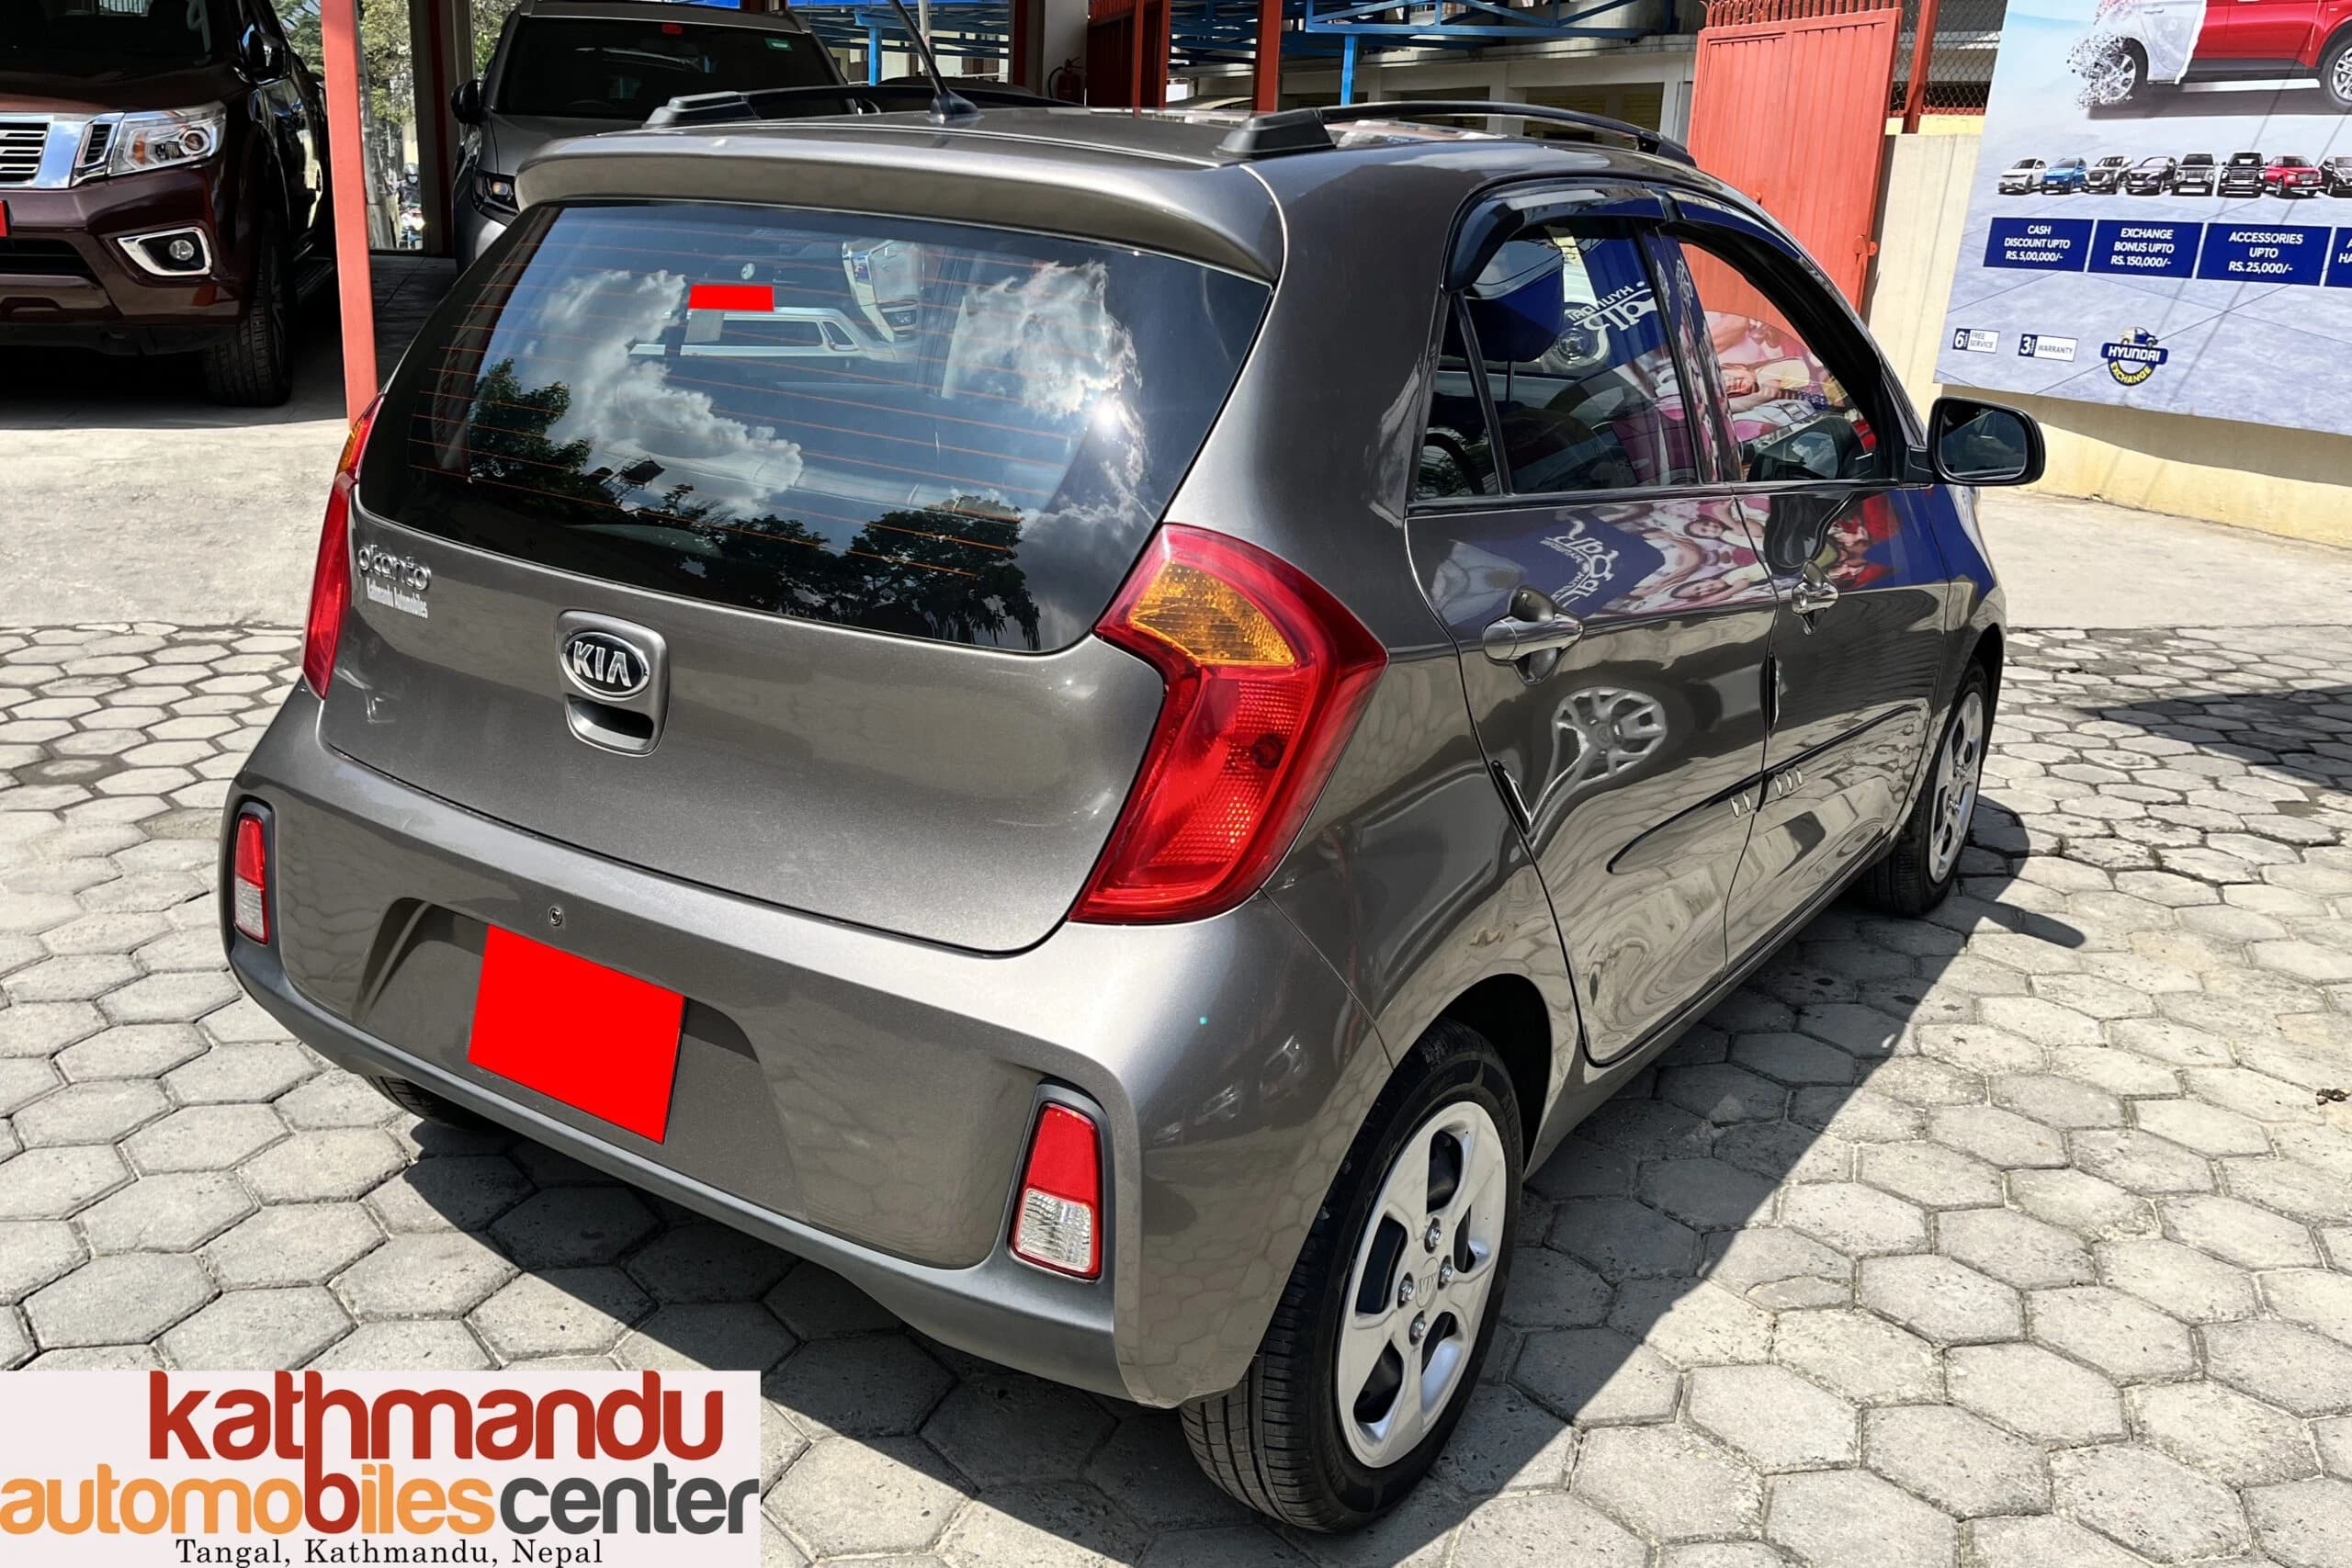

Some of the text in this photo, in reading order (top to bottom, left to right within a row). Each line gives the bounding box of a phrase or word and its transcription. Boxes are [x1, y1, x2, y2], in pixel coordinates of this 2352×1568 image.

[2027, 225, 2052, 235] CASH
[2120, 227, 2175, 240] EXCHANGE
[2004, 237, 2071, 249] DISCOUNT UPTO
[2228, 231, 2304, 244] ACCESSORIES
[2114, 242, 2175, 254] BONUS UPTO
[2249, 247, 2279, 258] UPTO
[2006, 251, 2064, 263] RS. 5,00,000/-
[2110, 254, 2172, 268] RS. 150,000/-
[2228, 261, 2293, 275] RS. 25,000/-
[1954, 331, 1965, 348] 6
[1971, 332, 1985, 340] FREE
[1970, 339, 1994, 348] SERVICE
[2020, 336, 2031, 355] 3
[2038, 344, 2075, 355] WARRANTY
[2108, 345, 2161, 362] HYUNDAI
[2109, 361, 2153, 384] EXCHANGE
[573, 641, 632, 687] KIA
